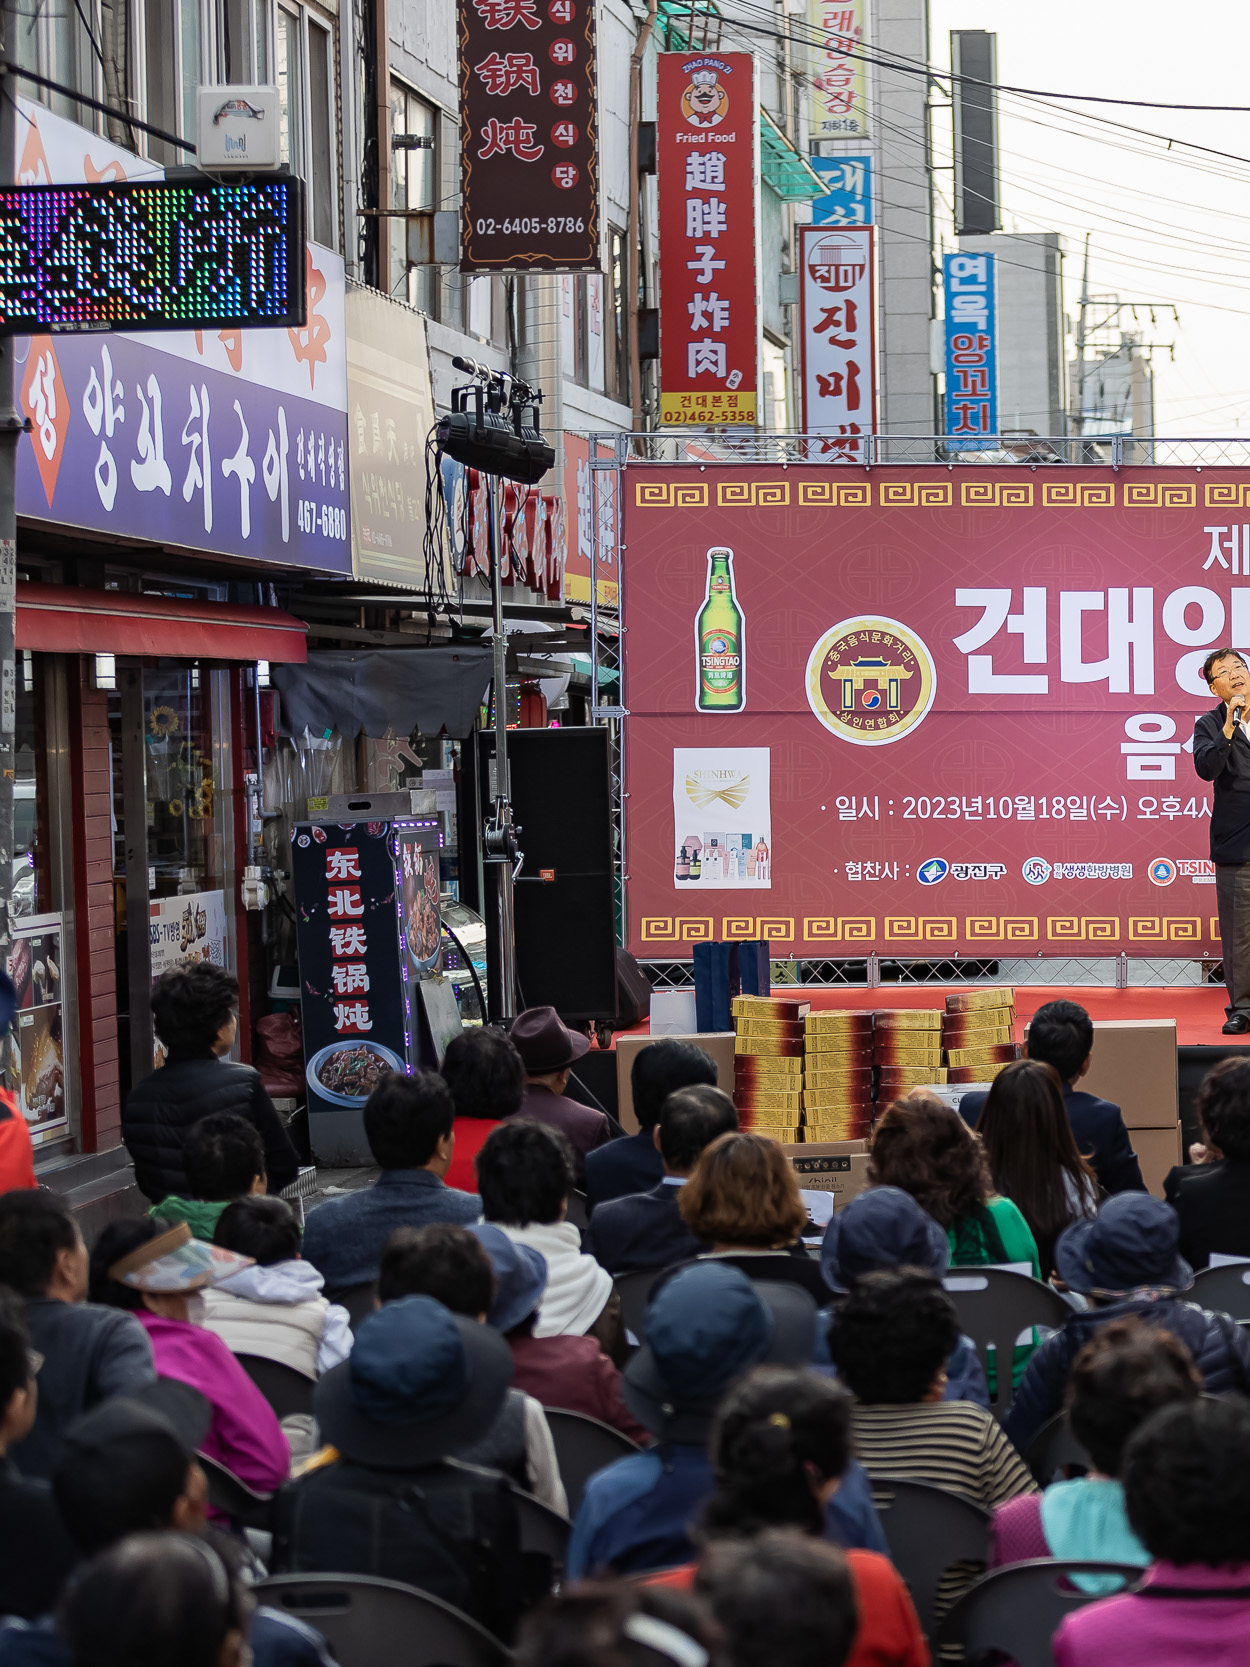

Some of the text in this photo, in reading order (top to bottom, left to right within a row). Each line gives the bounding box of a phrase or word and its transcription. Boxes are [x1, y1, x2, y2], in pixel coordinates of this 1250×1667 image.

[683, 58, 733, 75] ZHAO PANG ZI
[820, 0, 859, 114] 래연습장
[551, 1, 578, 188] 식위천식당
[676, 131, 736, 144] Fried Food
[476, 216, 585, 235] 02-6405-8786
[684, 150, 731, 379] 趙胖子炸肉
[814, 265, 860, 288] 진미
[680, 394, 740, 409] 건대본점
[664, 409, 756, 424] 02)462-5358
[298, 499, 347, 541] 467-6880
[828, 630, 915, 663] 중국음식문화거리
[701, 656, 740, 667] TSINGTAO
[839, 711, 901, 731] 상인연합회
[693, 769, 743, 779] SHINHWA
[835, 795, 880, 821] 일시
[902, 794, 1128, 822] 2023년10월18일(수)
[845, 860, 900, 882] 협찬사
[952, 864, 1006, 880] 광진구
[1063, 863, 1133, 879] 생생한방병원
[325, 850, 374, 1031] 东北铁锅炖
